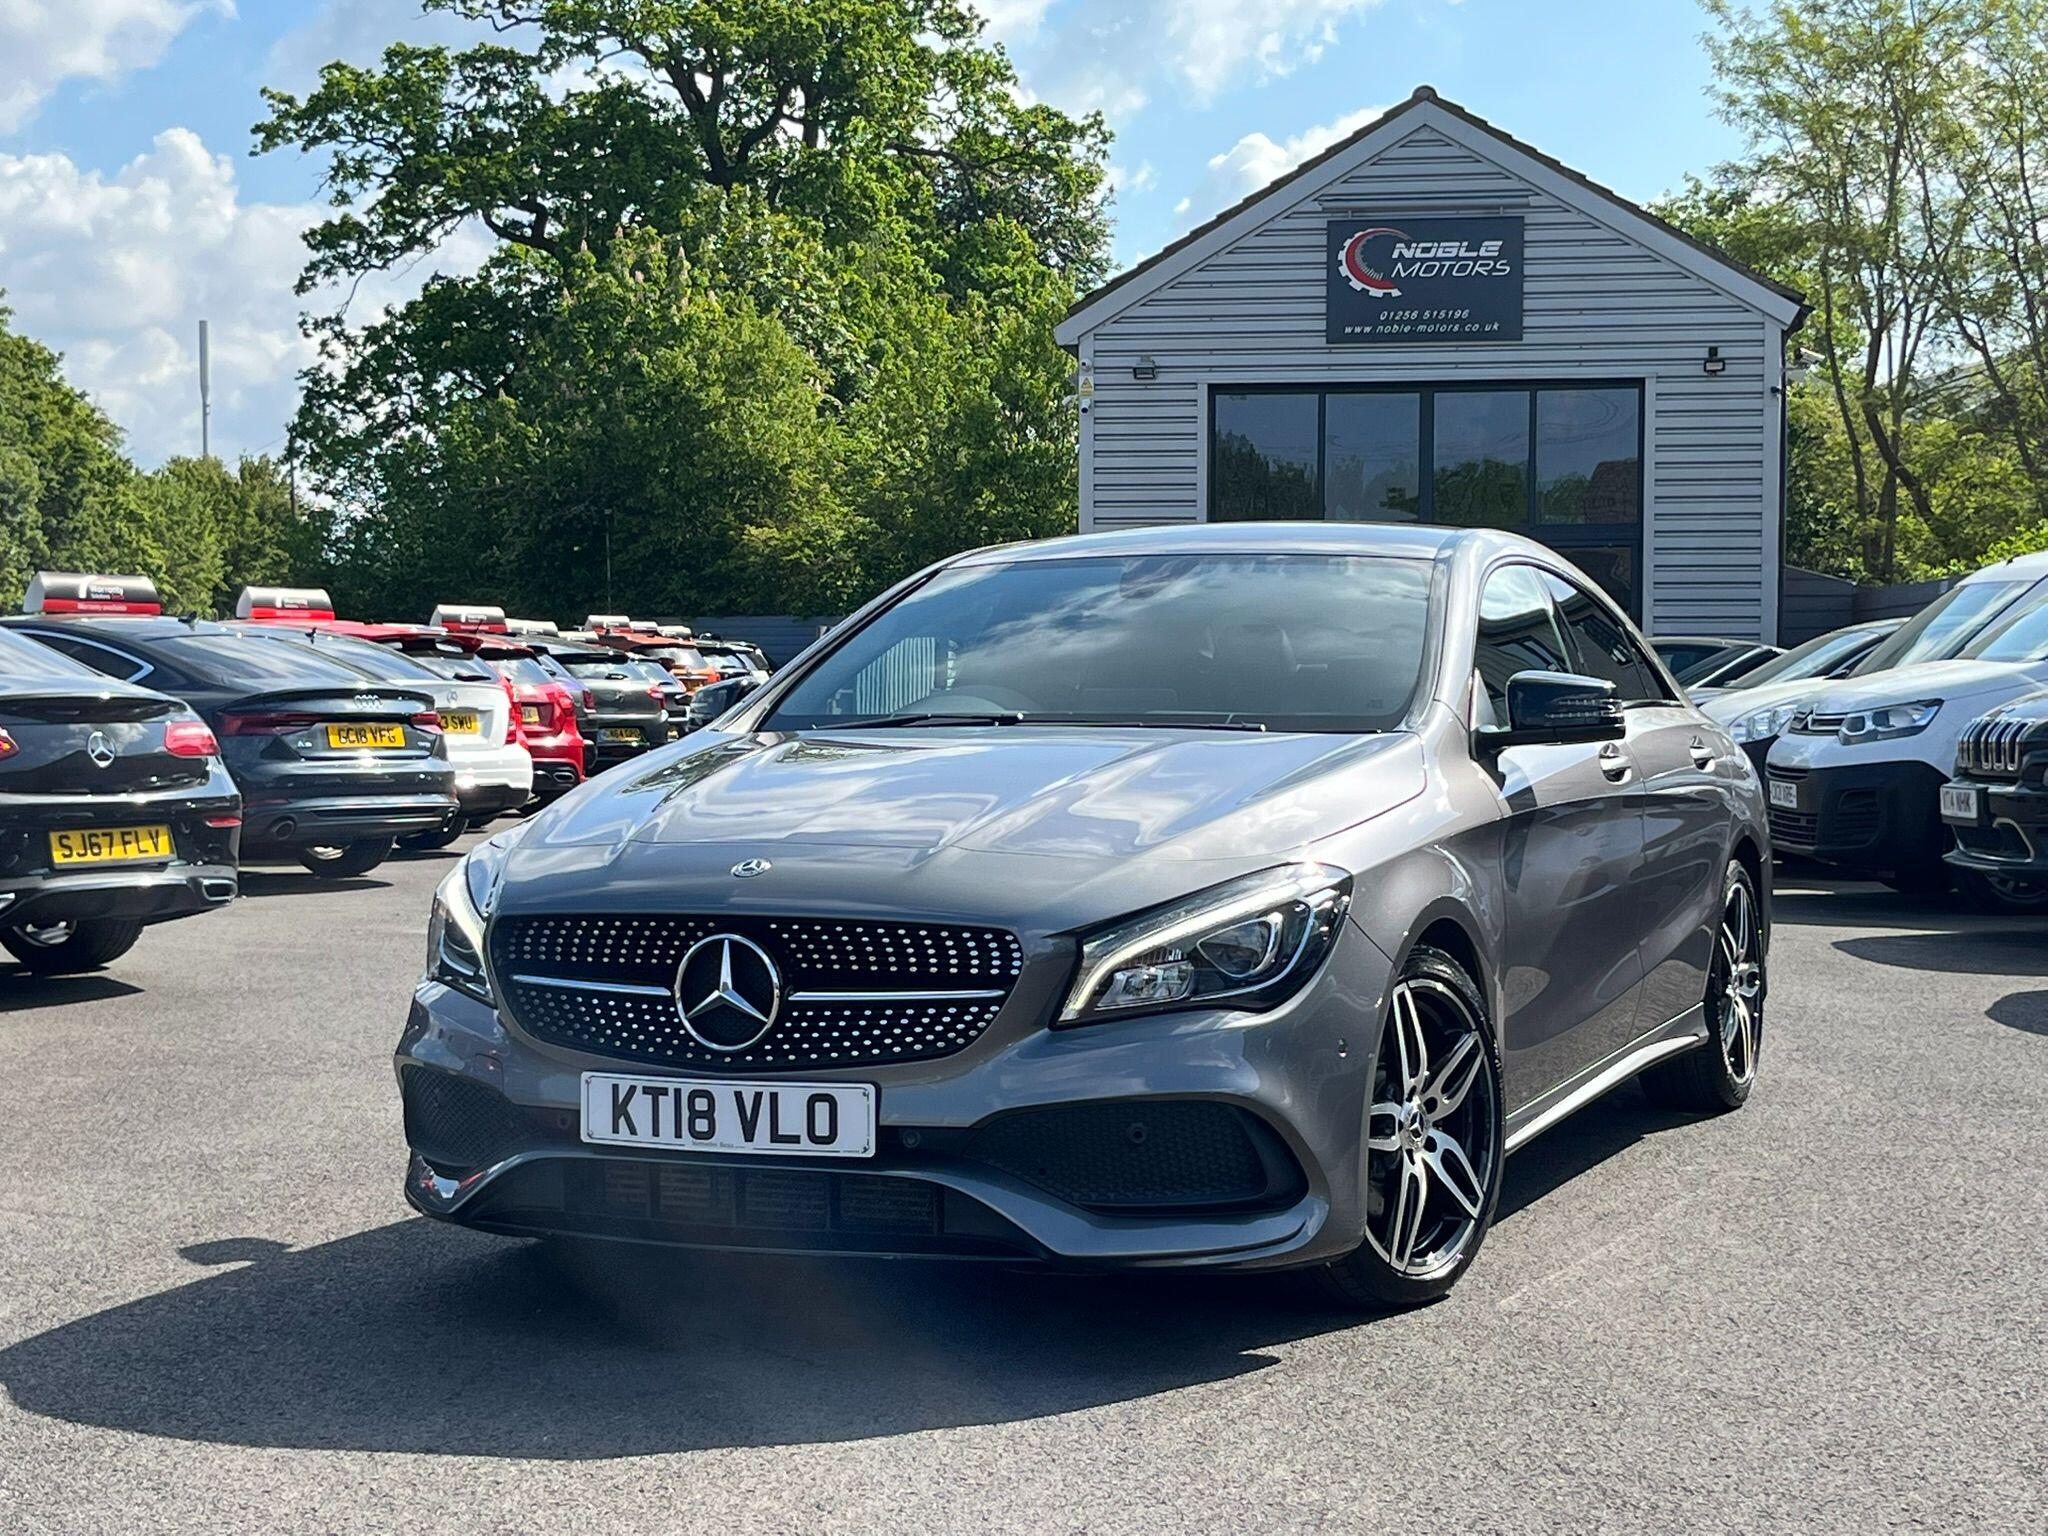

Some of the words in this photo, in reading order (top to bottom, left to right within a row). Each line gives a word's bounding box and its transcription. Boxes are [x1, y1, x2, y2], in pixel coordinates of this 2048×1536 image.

[1391, 240, 1504, 259] NOBLE
[1390, 259, 1511, 278] MOTORS
[1379, 310, 1419, 321] 01256
[1422, 309, 1470, 320] 515196
[371, 725, 396, 744] VFG
[58, 831, 115, 859] SJ67
[120, 828, 160, 855] FLV
[611, 1083, 717, 1141] KT18
[733, 1090, 838, 1146] VLO
